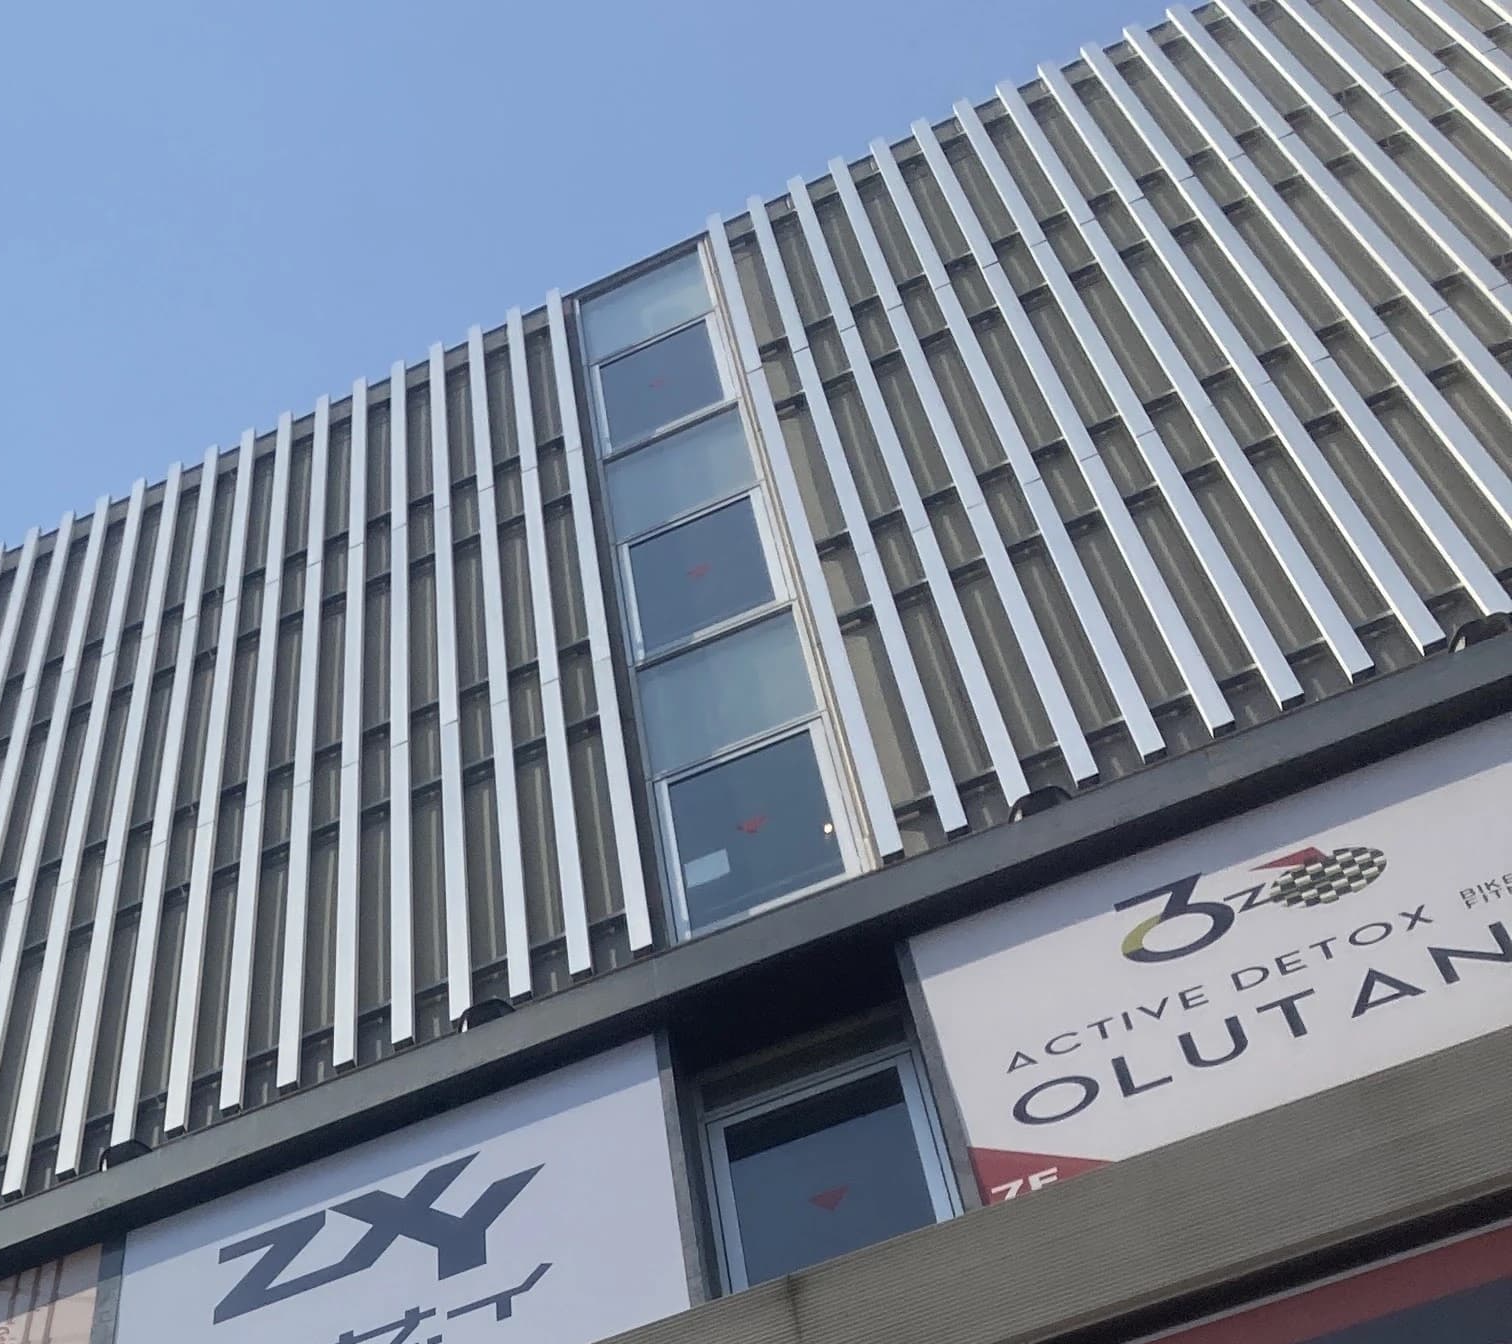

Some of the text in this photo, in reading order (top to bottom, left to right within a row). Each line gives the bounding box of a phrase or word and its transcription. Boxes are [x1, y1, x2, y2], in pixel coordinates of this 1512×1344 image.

[1006, 905, 1433, 1073] ACTIVE DETOX
[991, 1166, 1058, 1200] 7F
